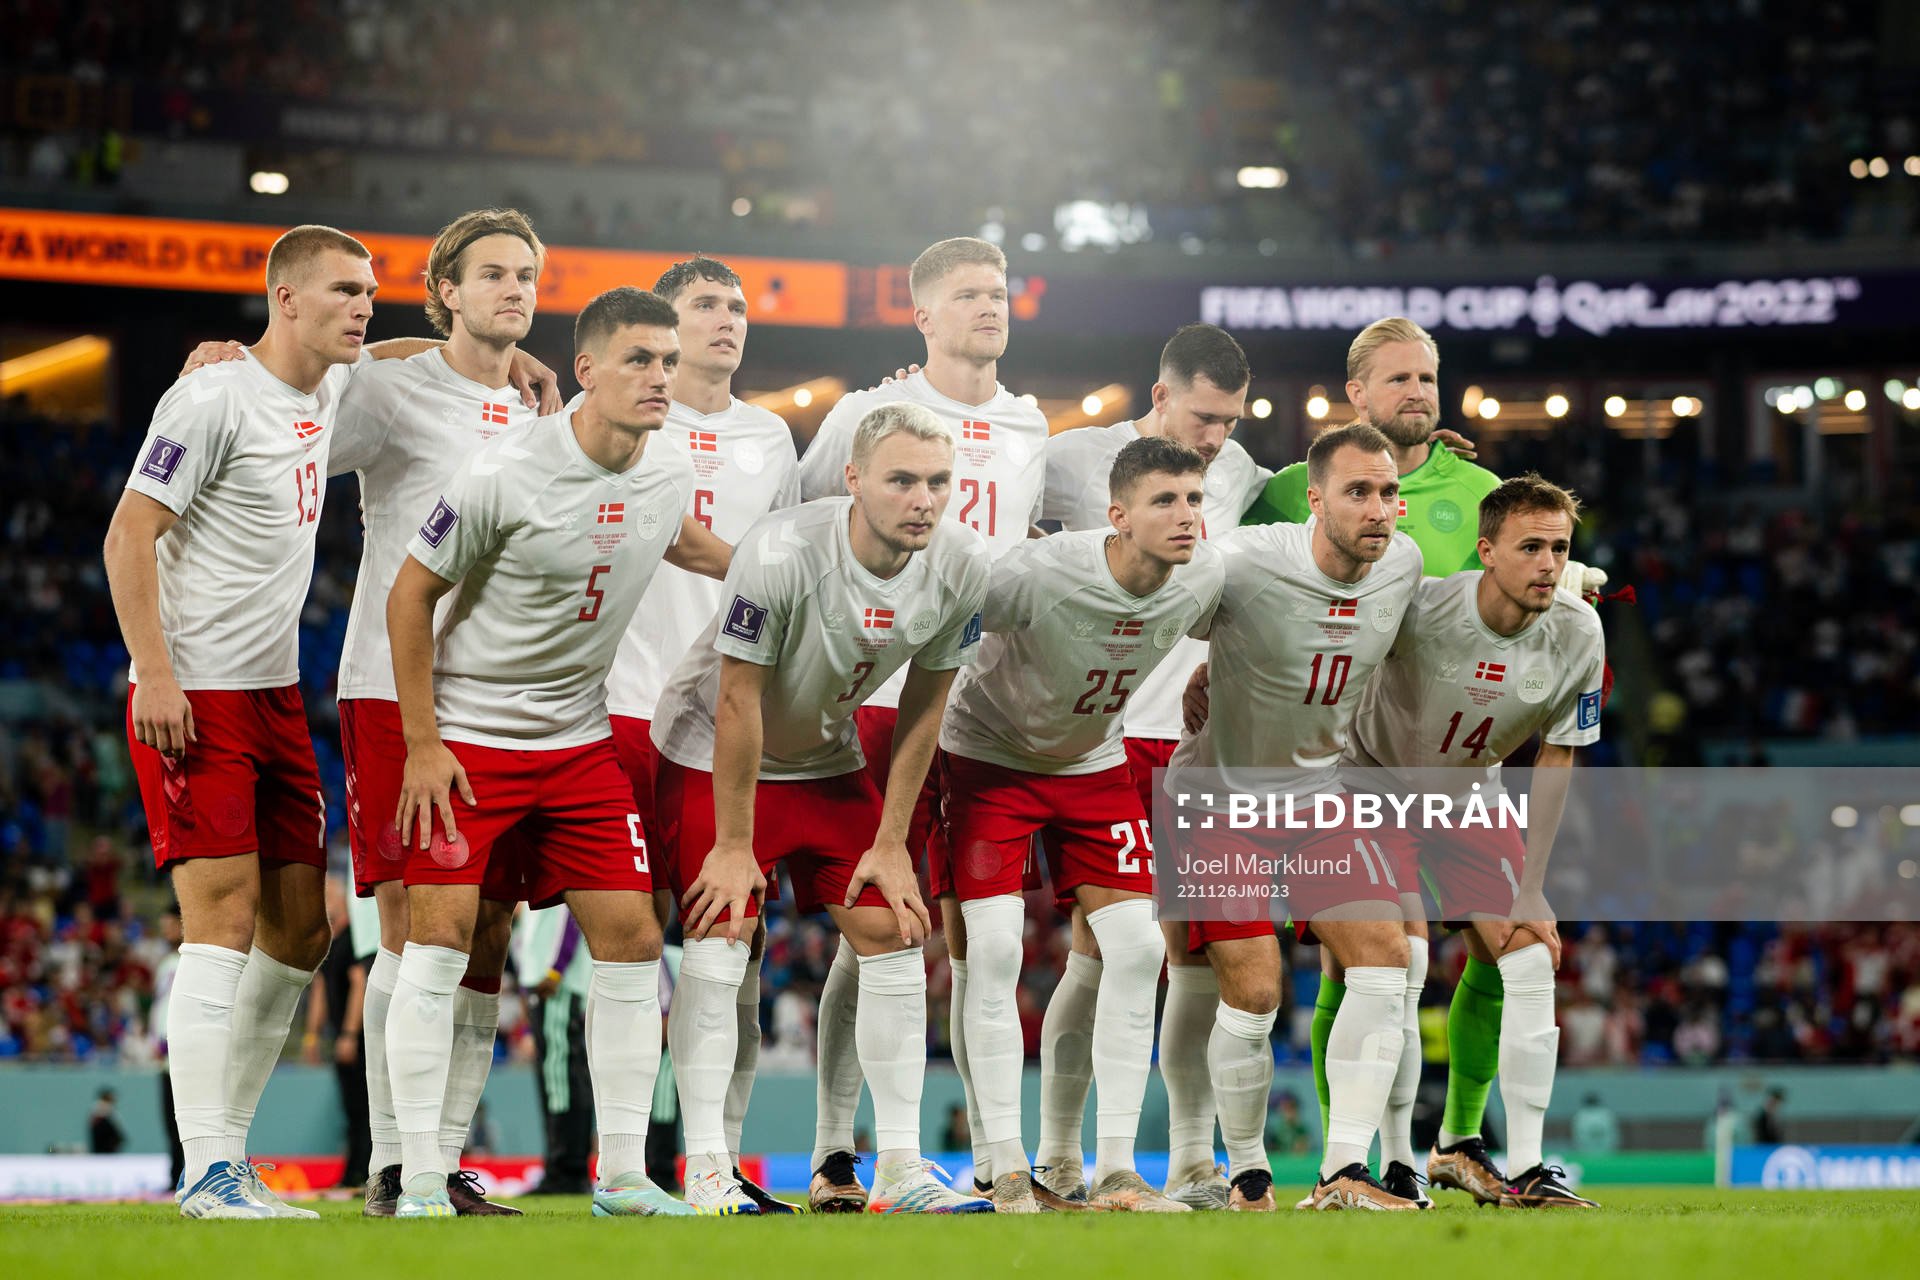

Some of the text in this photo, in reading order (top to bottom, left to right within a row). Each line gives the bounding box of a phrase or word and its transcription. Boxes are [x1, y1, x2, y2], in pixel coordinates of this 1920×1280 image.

[43, 233, 188, 272] WORLD
[1201, 286, 1293, 329] FIFA
[1294, 286, 1443, 329] WORLD
[1446, 286, 1530, 329] CUP
[295, 461, 318, 528] 13
[959, 478, 997, 537] 21
[578, 565, 612, 622] 5
[837, 661, 875, 703] 3
[1072, 668, 1137, 715] 25
[1303, 653, 1353, 705] 10
[1439, 711, 1494, 759] 14
[626, 813, 650, 873] 5
